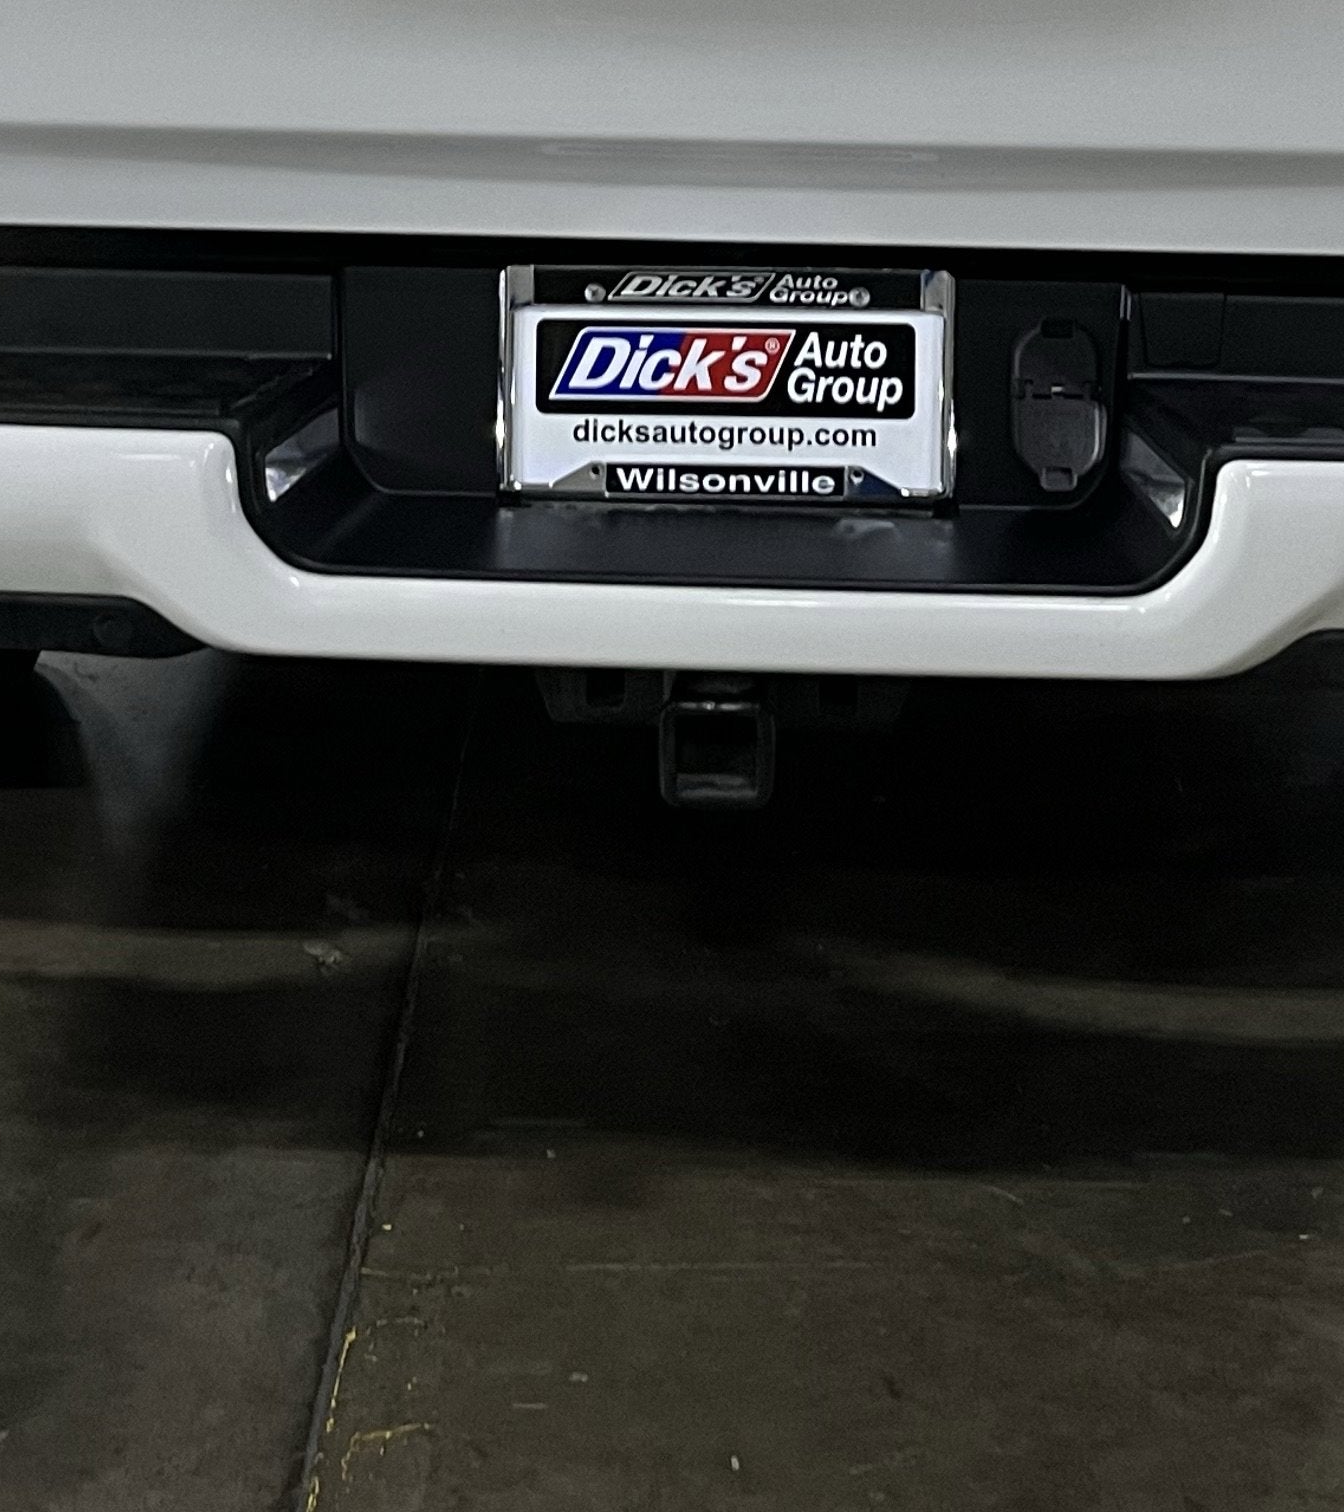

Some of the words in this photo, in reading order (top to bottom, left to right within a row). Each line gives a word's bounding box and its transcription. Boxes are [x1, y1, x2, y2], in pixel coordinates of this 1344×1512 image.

[619, 274, 758, 298] Dick's
[775, 274, 838, 289] Auto
[769, 288, 849, 306] Group
[568, 334, 766, 392] Dick's
[796, 332, 888, 370] Auto
[787, 369, 904, 411] Group
[573, 419, 877, 451] dicksautogroup.com
[616, 467, 836, 496] Wilsonville
